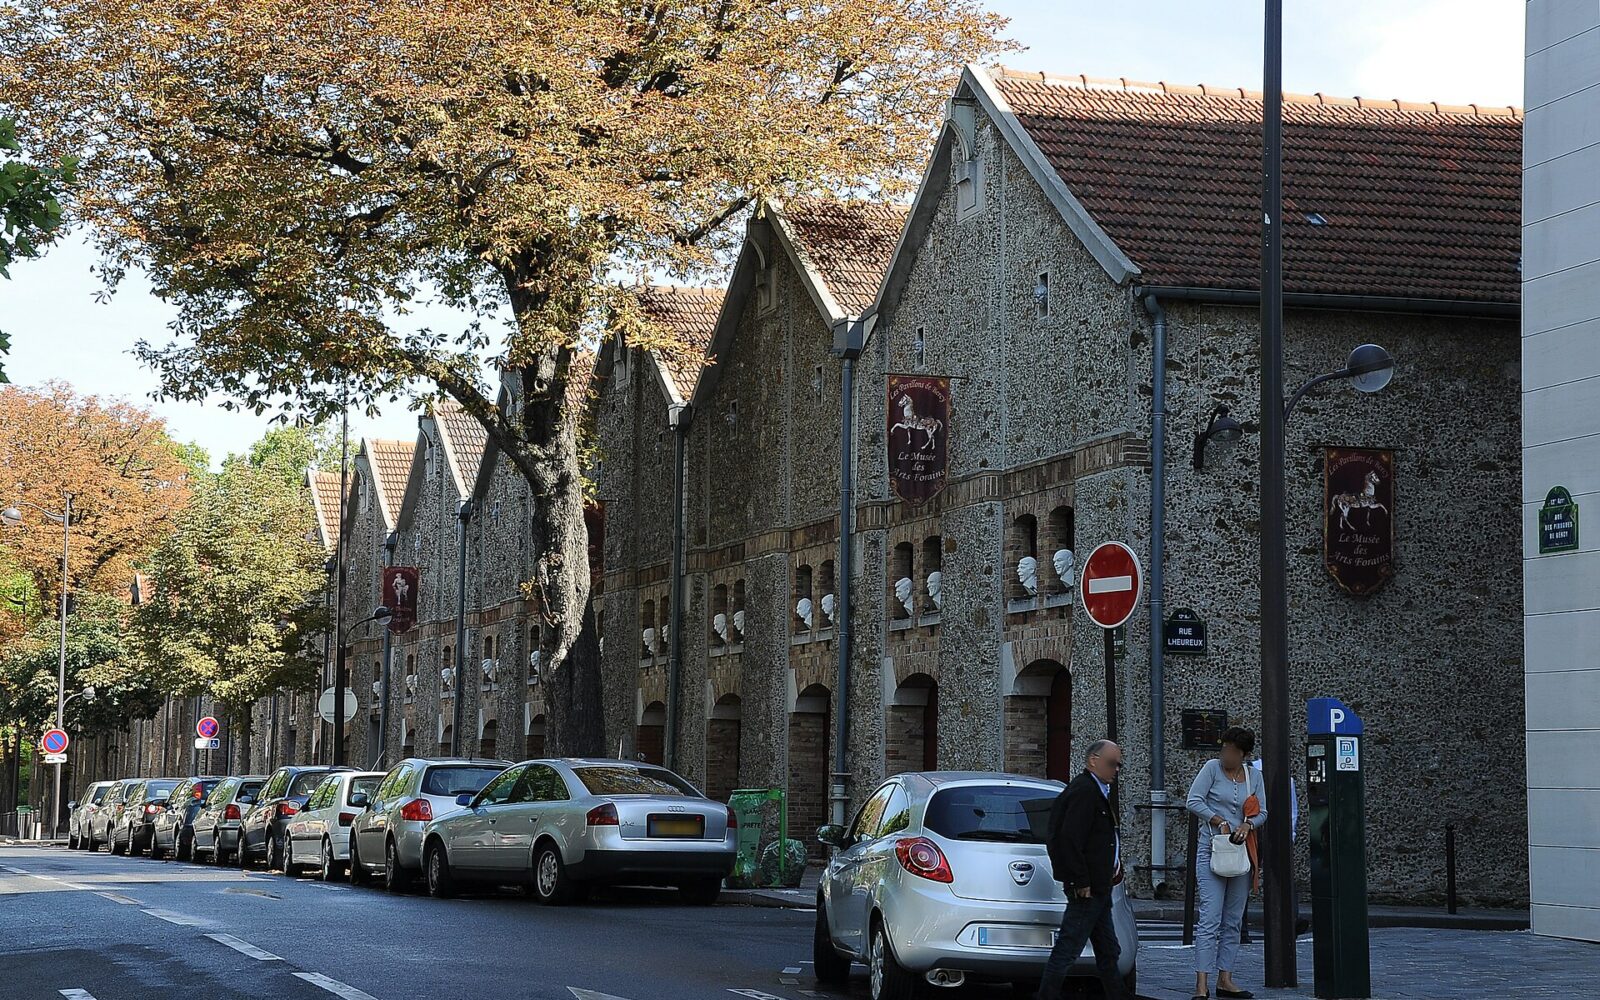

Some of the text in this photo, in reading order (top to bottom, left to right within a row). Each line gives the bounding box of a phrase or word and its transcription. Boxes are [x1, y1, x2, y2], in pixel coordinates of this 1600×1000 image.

[898, 452, 935, 461] Le Musée
[912, 460, 925, 471] des
[892, 468, 945, 481] Arts Forains
[1338, 533, 1380, 544] Le Musée
[1353, 544, 1367, 555] des
[1332, 551, 1390, 567] Arts Forains
[1168, 638, 1203, 646] LHEUREUX
[1330, 709, 1344, 732] P
